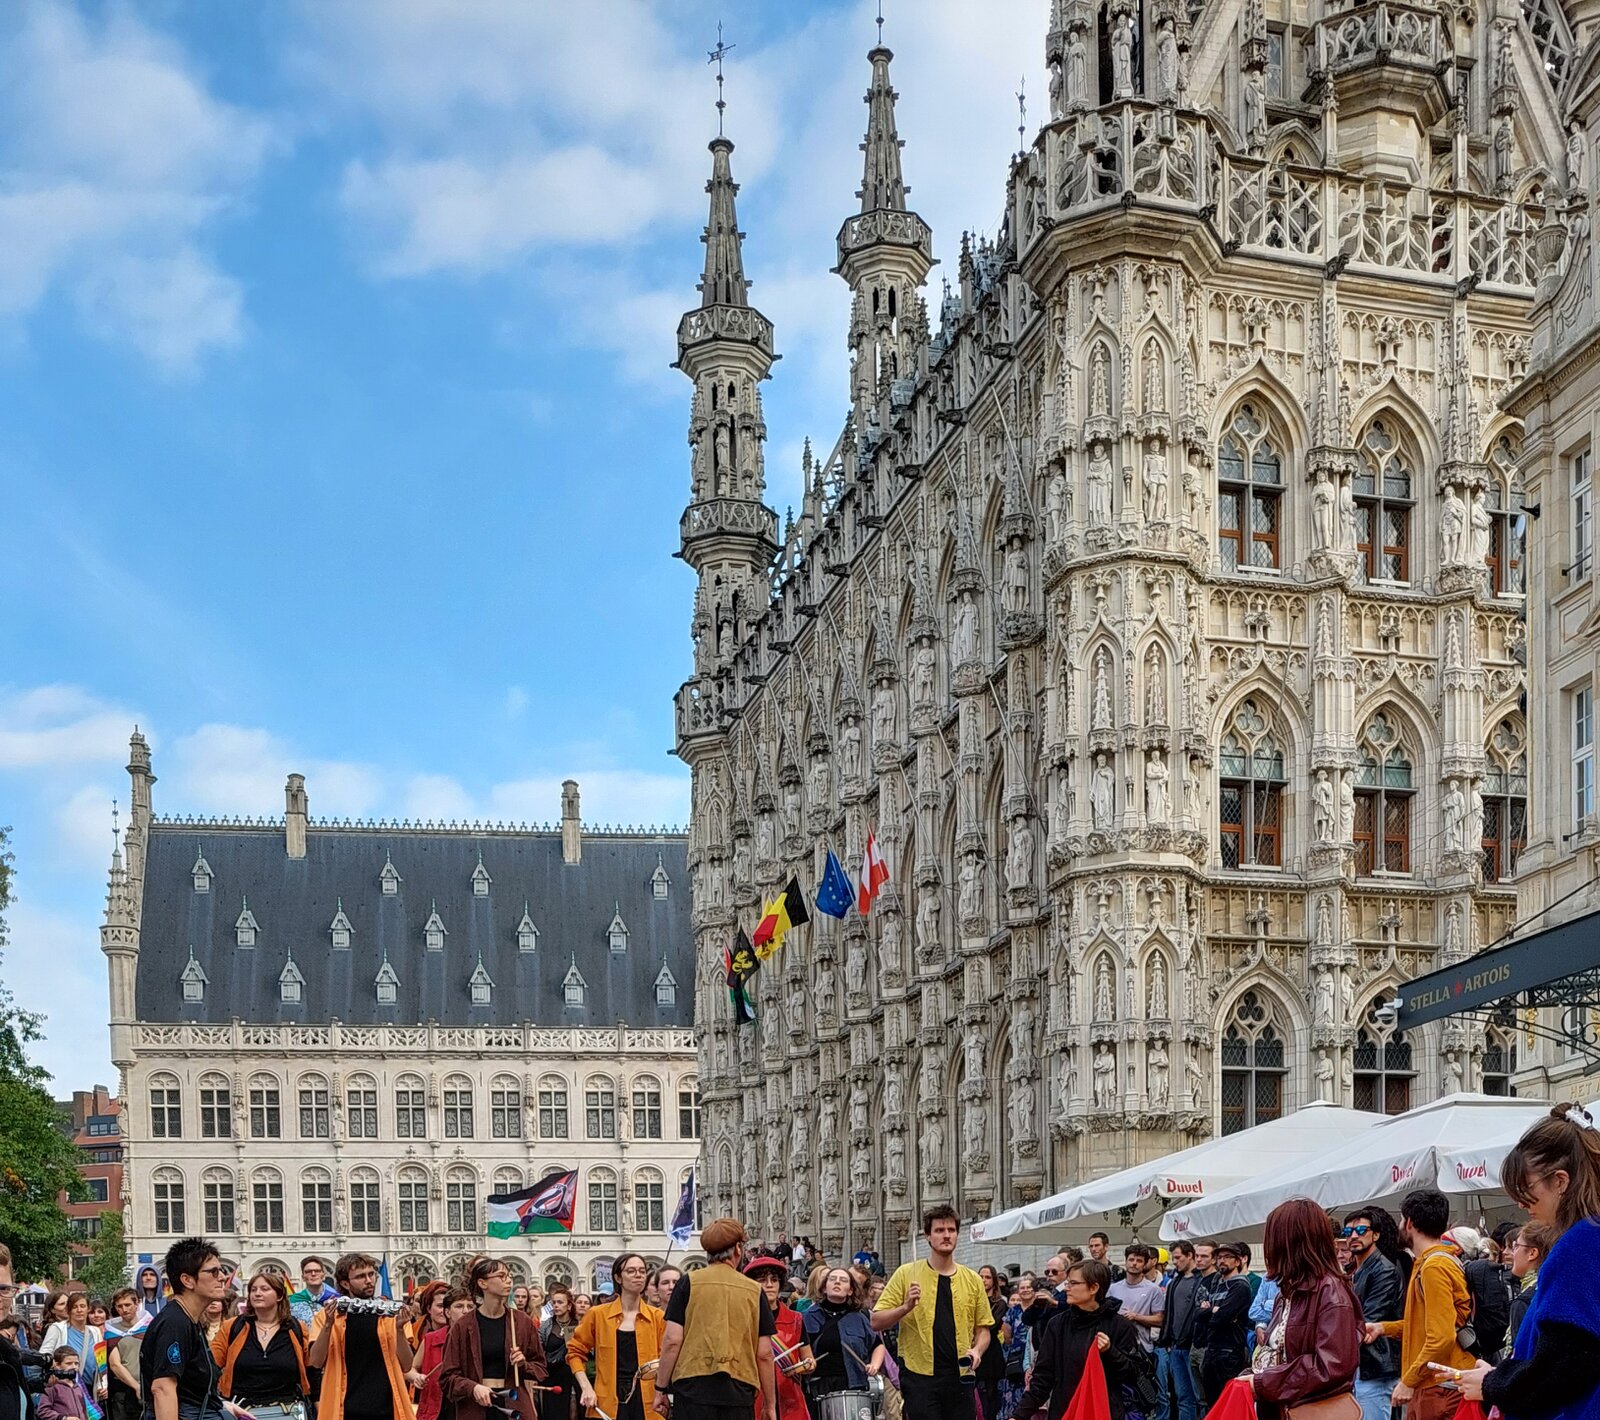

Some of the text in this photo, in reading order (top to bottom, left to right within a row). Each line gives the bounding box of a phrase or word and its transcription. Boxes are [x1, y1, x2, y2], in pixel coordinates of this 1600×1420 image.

[1410, 964, 1511, 1012] STELLA ARTOIS
[1456, 1160, 1487, 1180] Duvel
[1167, 1179, 1203, 1193] Duvel
